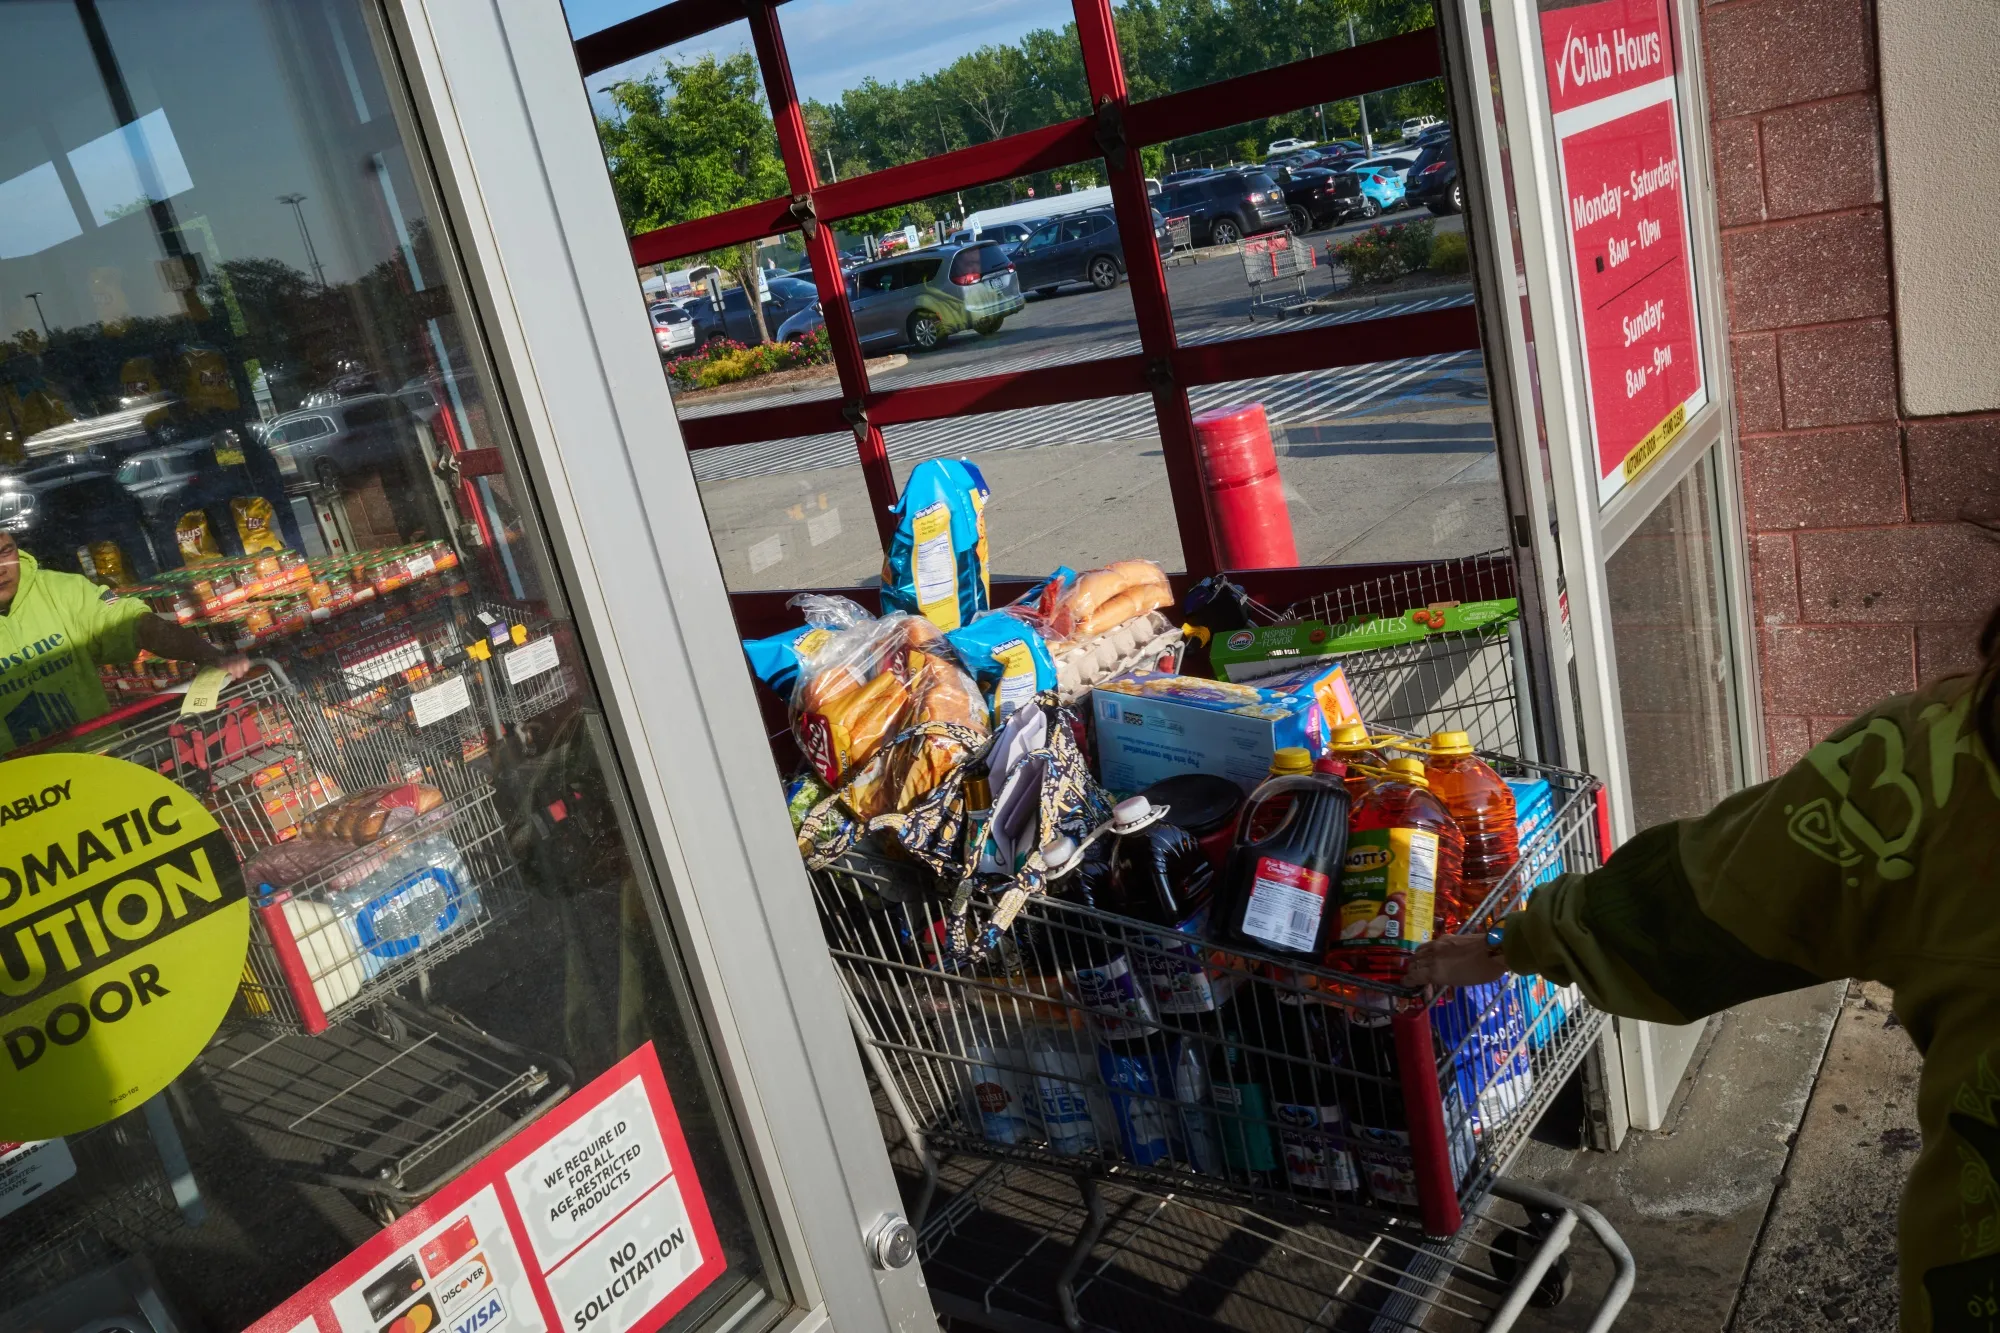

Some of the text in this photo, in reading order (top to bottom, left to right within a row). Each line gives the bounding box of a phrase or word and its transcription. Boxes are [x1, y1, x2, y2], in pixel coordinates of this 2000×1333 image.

[1570, 28, 1660, 87] Club Hours
[1573, 182, 1621, 231] Monday
[1630, 157, 1678, 202] Saturday:
[1608, 237, 1630, 268] 8AM
[1637, 218, 1661, 250] 10PM
[1622, 299, 1665, 348] Sunday:
[1626, 365, 1646, 399] 8AM
[1653, 345, 1672, 376] 9PM
[205, 599, 222, 611] DIPS
[1328, 616, 1407, 639] TOMATES
[1261, 627, 1297, 640] INSPIRED
[1262, 637, 1294, 648] FLAVOR
[0, 779, 73, 827] ABLOY
[1345, 851, 1388, 867] MOTT'S
[3, 963, 172, 1072] DOOR
[543, 1120, 627, 1190] WE REQUIRE ID
[568, 1148, 615, 1189] FOR ALL
[550, 1143, 642, 1222] AGE-RESTRICTED
[570, 1169, 632, 1222] PRODUCTS
[573, 1227, 686, 1332] SOLICITATION
[608, 1242, 637, 1274] NO
[441, 1265, 485, 1305] DISCOVER
[455, 1298, 502, 1333] VISA
